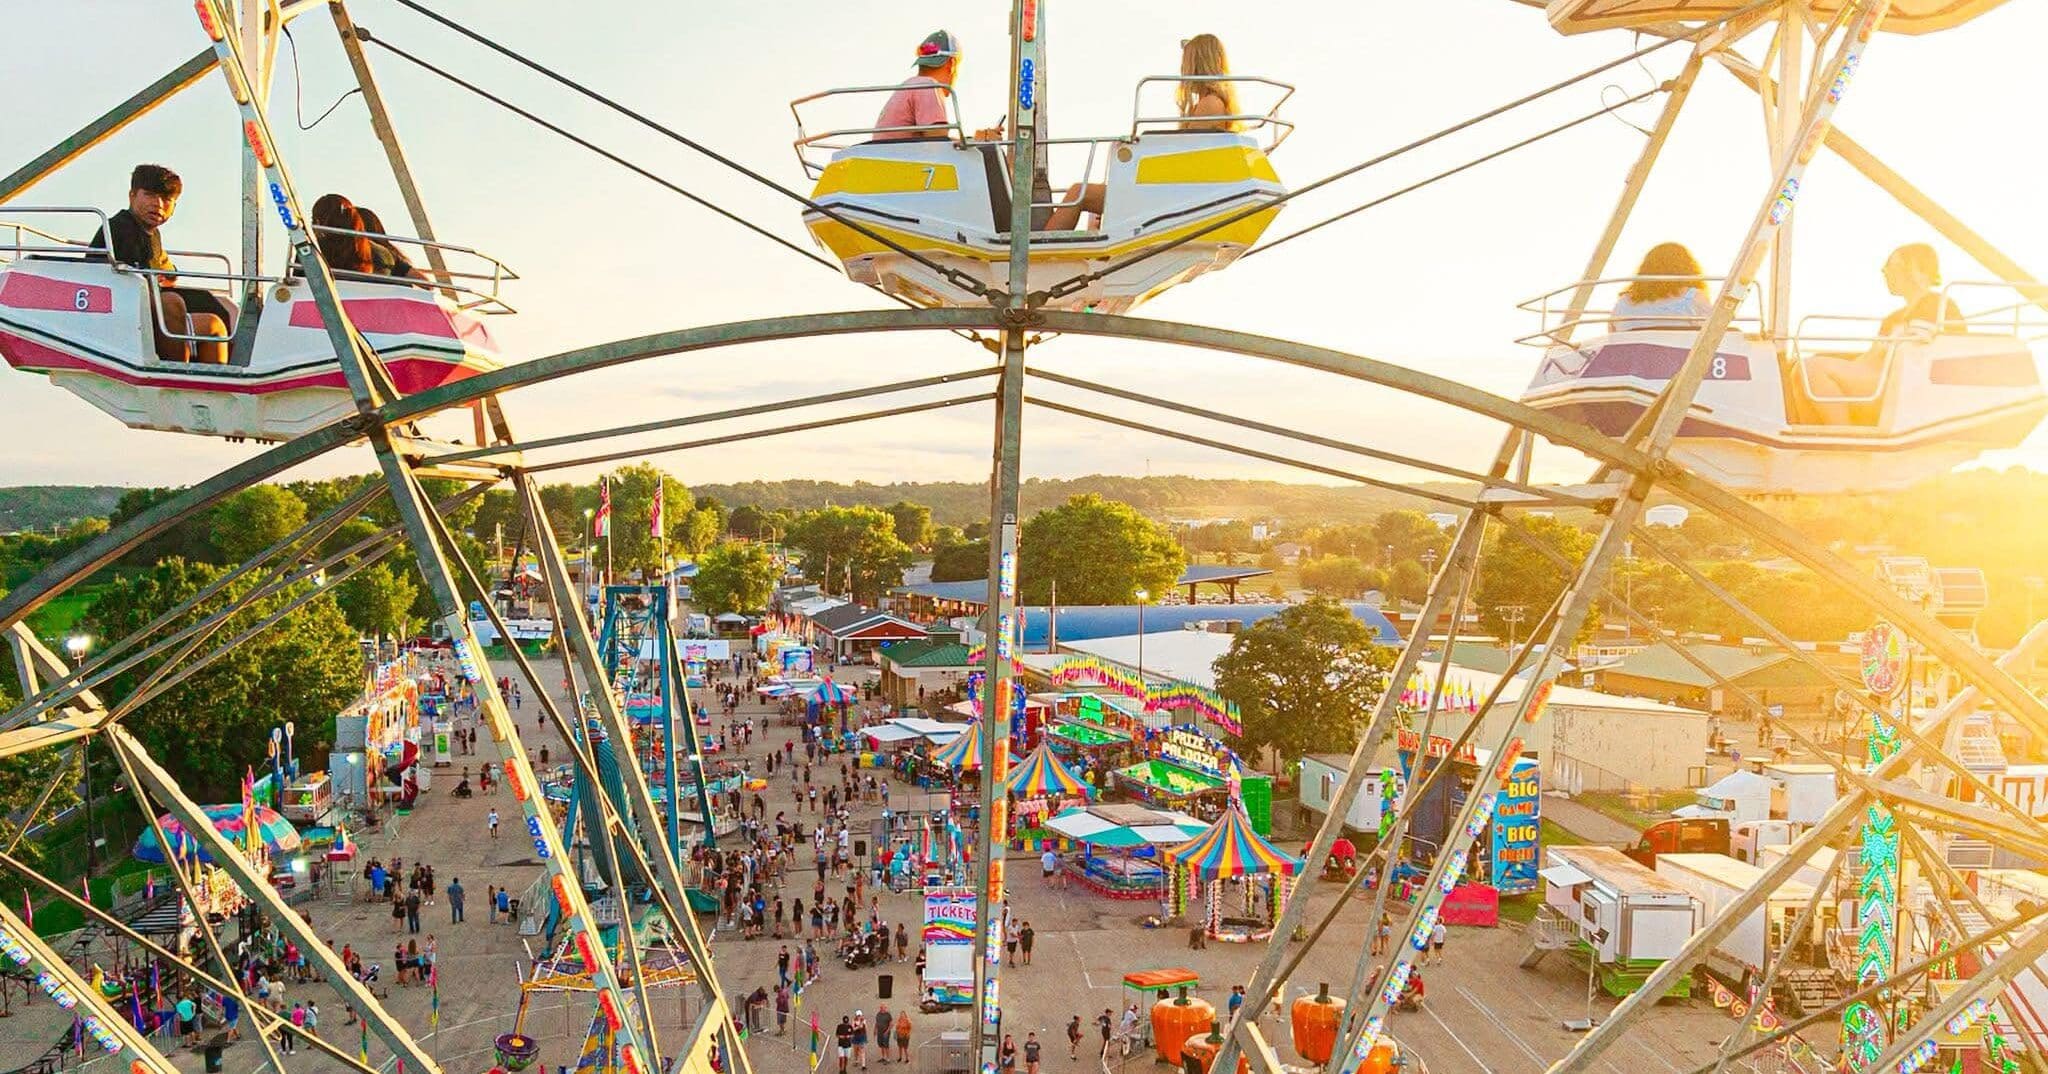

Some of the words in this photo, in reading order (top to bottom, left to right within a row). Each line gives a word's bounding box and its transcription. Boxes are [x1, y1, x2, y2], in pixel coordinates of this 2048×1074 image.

[923, 168, 935, 190] 7
[76, 288, 89, 310] 6
[1712, 357, 1726, 379] 8
[1173, 730, 1206, 754] PRIZE
[1162, 742, 1219, 769] PALOOZA
[1508, 780, 1538, 798] BIG
[1498, 801, 1534, 817] GAME
[1507, 825, 1537, 842] BIG
[929, 906, 977, 921] TICKETS
